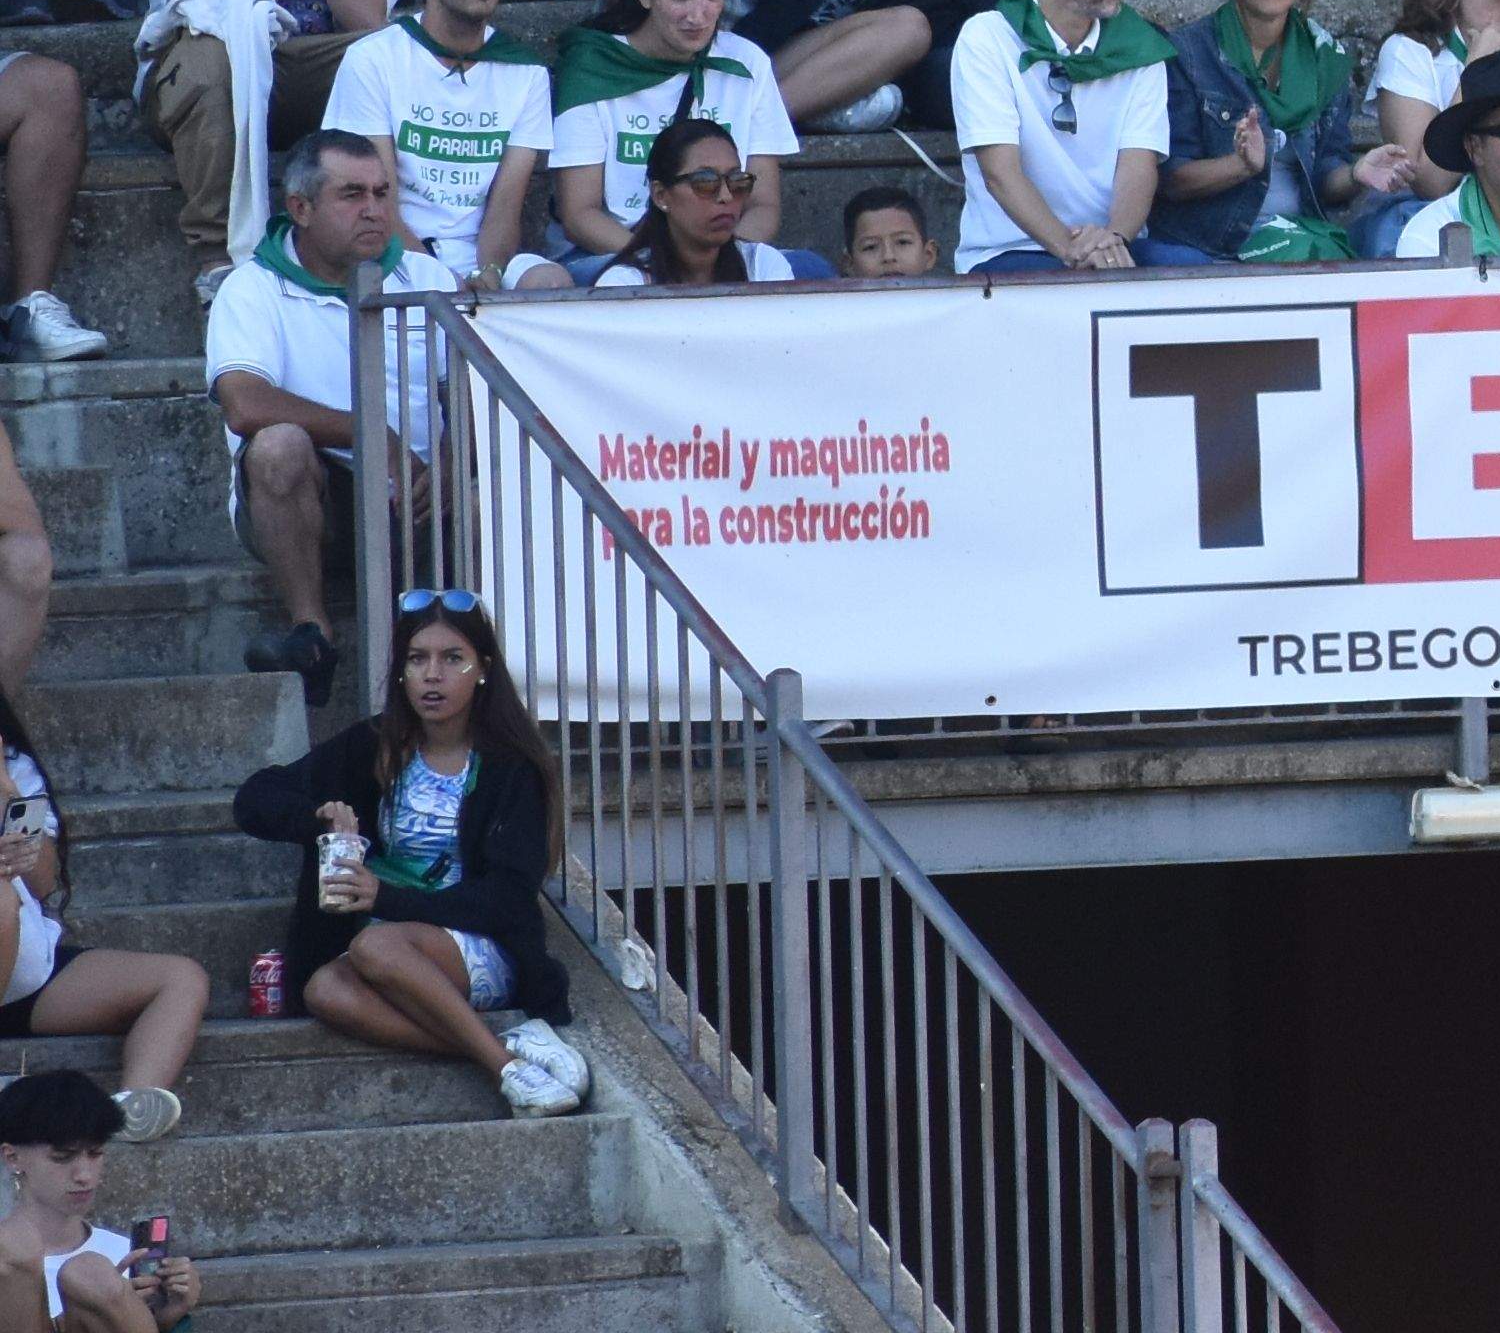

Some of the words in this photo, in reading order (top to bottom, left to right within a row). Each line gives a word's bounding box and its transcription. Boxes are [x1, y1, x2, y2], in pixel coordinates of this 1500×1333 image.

[411, 103, 434, 122] YO
[441, 110, 473, 128] SOY
[479, 111, 499, 128] DE
[626, 114, 650, 130] YO
[407, 129, 421, 151] LA
[428, 135, 503, 157] PARRILLA
[624, 140, 645, 159] LA
[598, 423, 731, 482] Material
[740, 438, 761, 492] y
[769, 416, 951, 489] maquinaria
[681, 494, 711, 546] la
[718, 483, 930, 546] construcción
